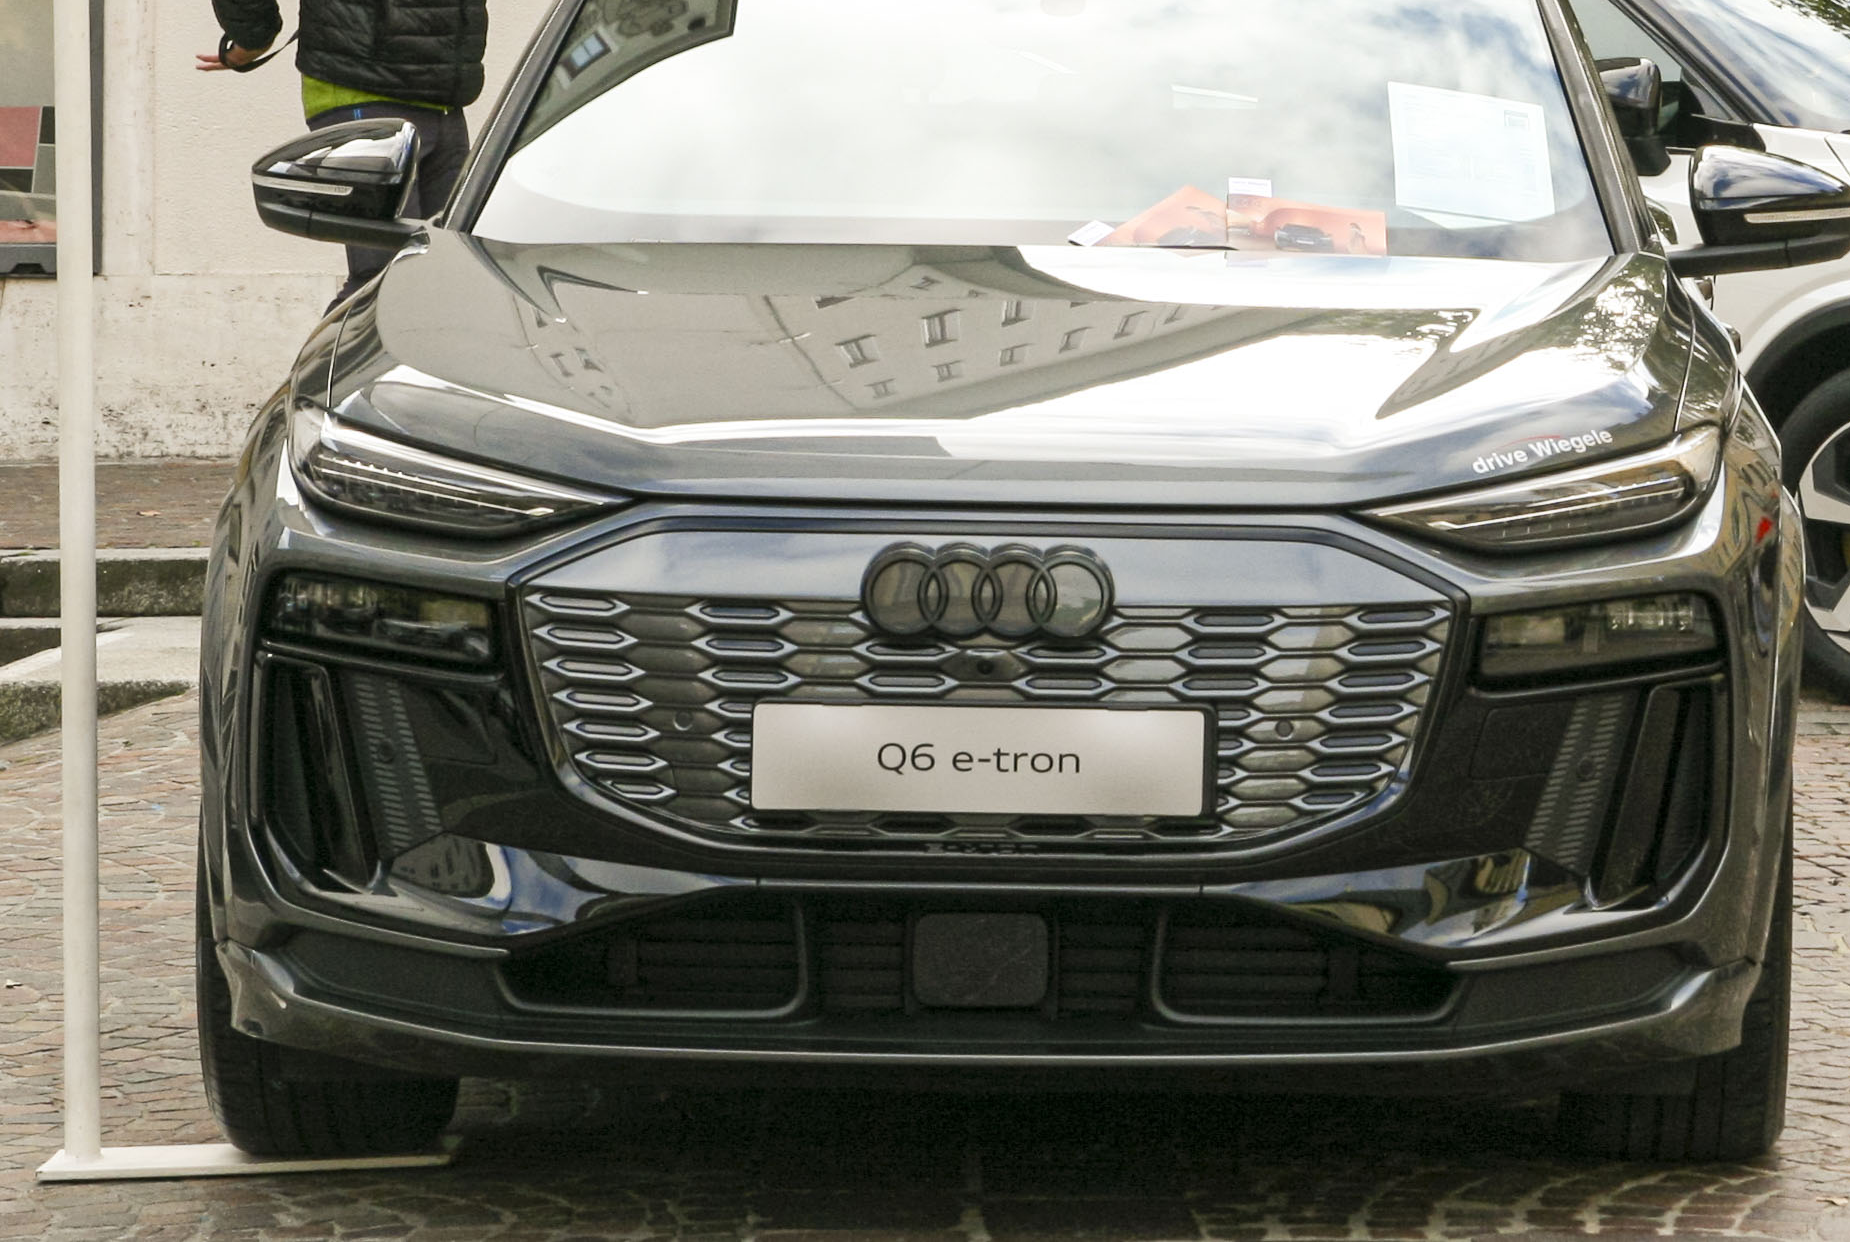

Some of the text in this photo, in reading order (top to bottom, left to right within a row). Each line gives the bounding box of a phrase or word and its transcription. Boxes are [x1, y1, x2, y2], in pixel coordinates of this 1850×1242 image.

[1527, 429, 1614, 454] Wiegele
[877, 742, 1080, 775] Q6 e-tron
